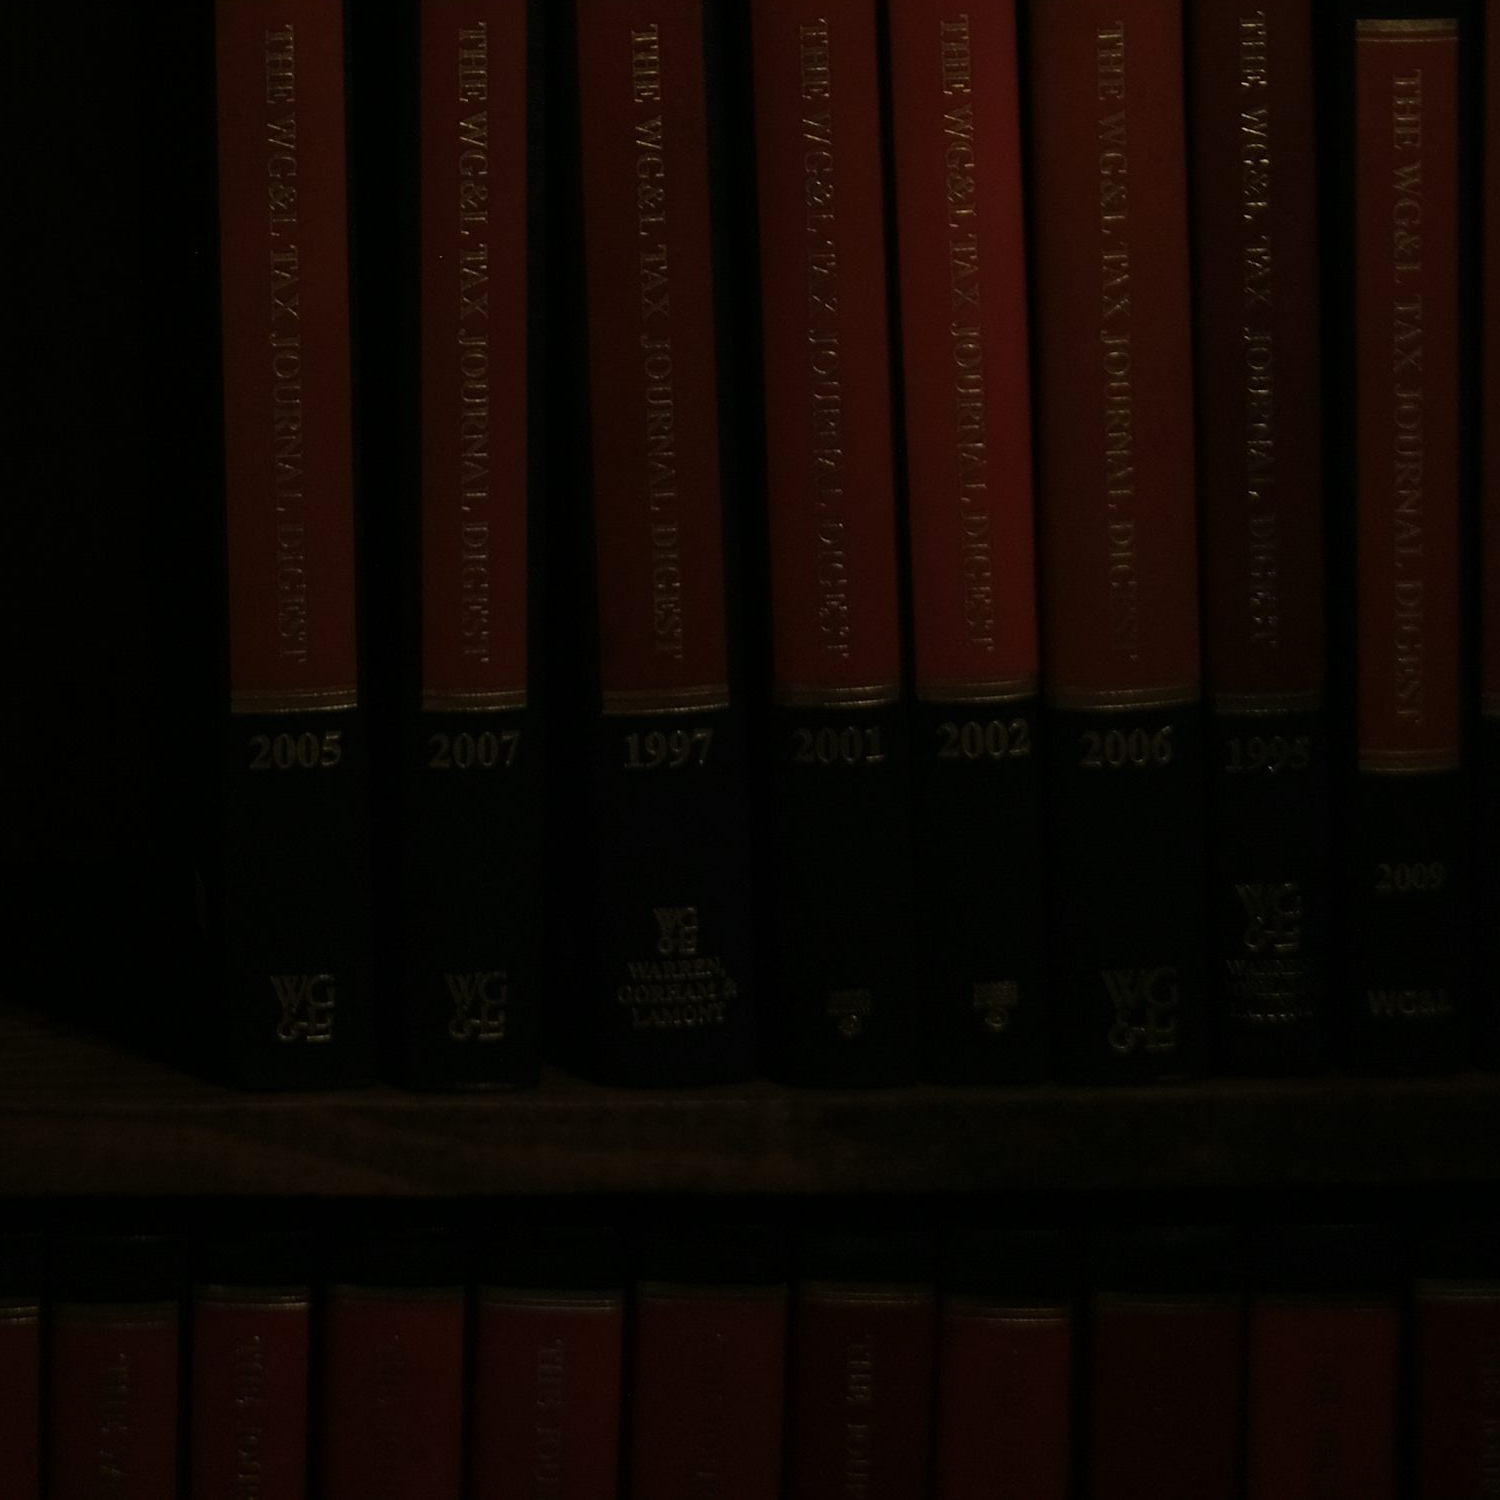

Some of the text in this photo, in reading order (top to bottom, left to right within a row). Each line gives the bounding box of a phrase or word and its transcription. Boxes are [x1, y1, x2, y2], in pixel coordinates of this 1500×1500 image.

[263, 23, 297, 105] THE
[455, 20, 487, 103] THE
[629, 22, 661, 105] THE
[939, 13, 972, 96] THE
[1093, 19, 1125, 101] THE
[1391, 69, 1424, 150] THE
[267, 242, 300, 323] TAX
[458, 241, 490, 320] TAX
[638, 245, 672, 322] TAX
[948, 233, 982, 308] TAX
[1098, 239, 1132, 318] TAX
[1391, 293, 1424, 372] TAX
[269, 334, 306, 514] JOURNAL
[457, 329, 492, 512] JOURNAL
[640, 334, 678, 512] JOURNAL
[949, 322, 990, 505] JOURNAL
[1098, 328, 1136, 512] JOURNAL
[1392, 386, 1426, 569] JOURNAL
[247, 730, 343, 771] 2005
[427, 730, 522, 769] 2007
[622, 727, 714, 770] 1997
[790, 726, 886, 766] 2001
[935, 718, 1033, 760] 2002
[1078, 726, 1174, 769] 2006
